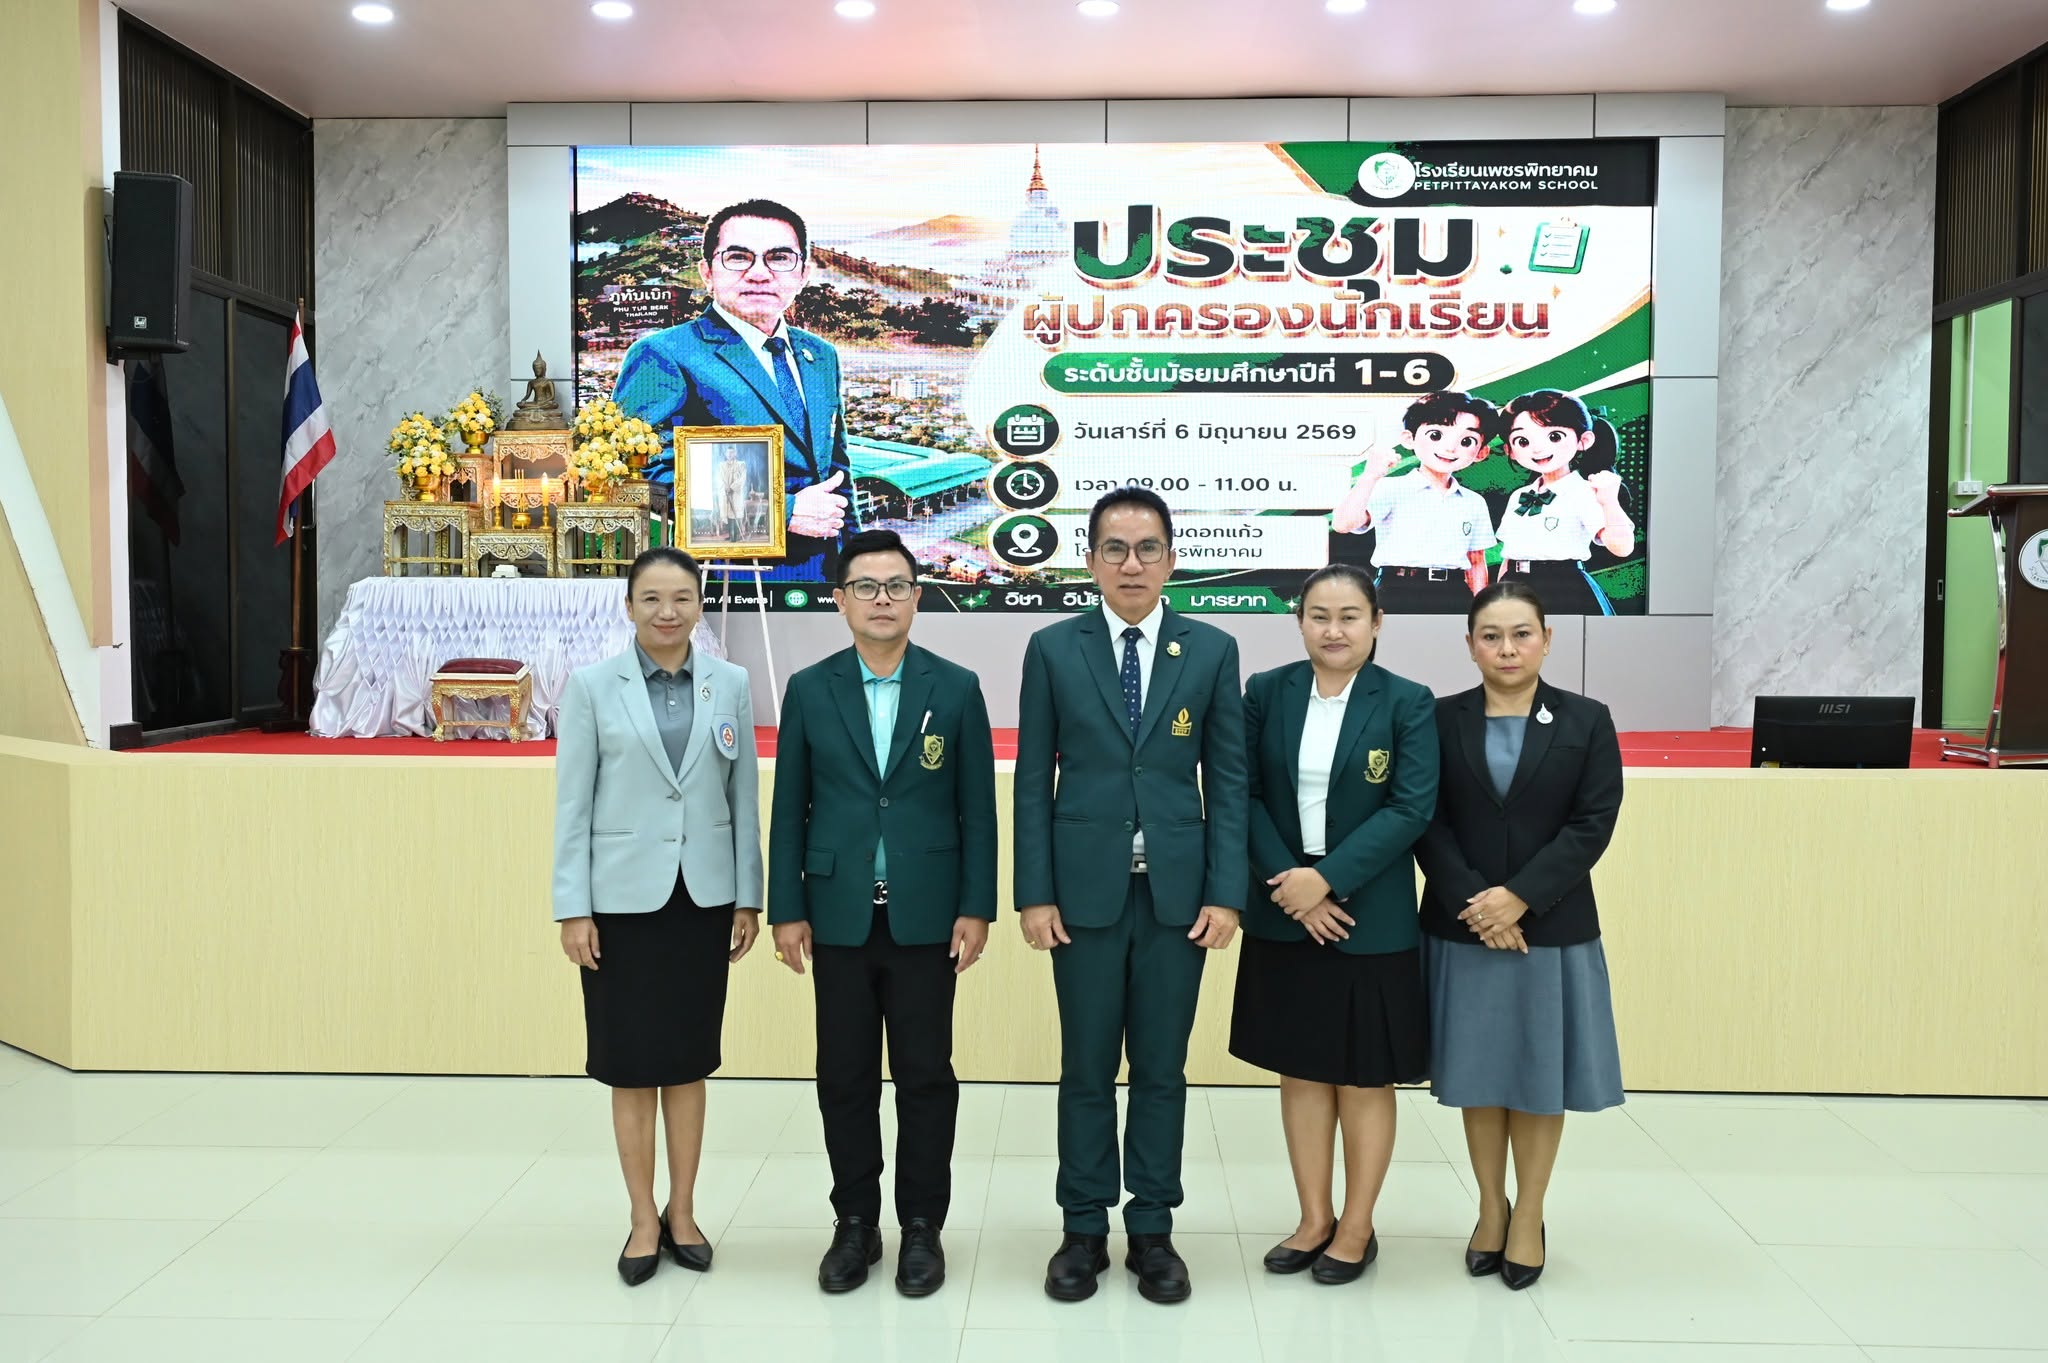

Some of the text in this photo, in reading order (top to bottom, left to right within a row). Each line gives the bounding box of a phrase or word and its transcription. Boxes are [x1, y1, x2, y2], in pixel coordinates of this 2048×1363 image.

[1415, 162, 1598, 178] โรงเรียนเพชรพิทยาคม
[1414, 180, 1599, 191] PETPITTAYAKOM SCHOOL
[1073, 204, 1476, 304] ประชุม
[609, 288, 672, 306] ภูทับเบิก
[1022, 291, 1551, 348] ผู้ปกครองนักเรียน
[1064, 357, 1431, 386] ระดับชั้นมัธยมศึกษาปีที่ 1-6
[1074, 418, 1357, 445] วันเสาร์ที่ 6 มิถุนายน 2569
[1126, 477, 1190, 491] 09.00
[1214, 477, 1270, 491] 11.00
[1278, 479, 1297, 492] น.
[1004, 591, 1043, 606] วิชา
[1190, 594, 1267, 607] มารยาท
